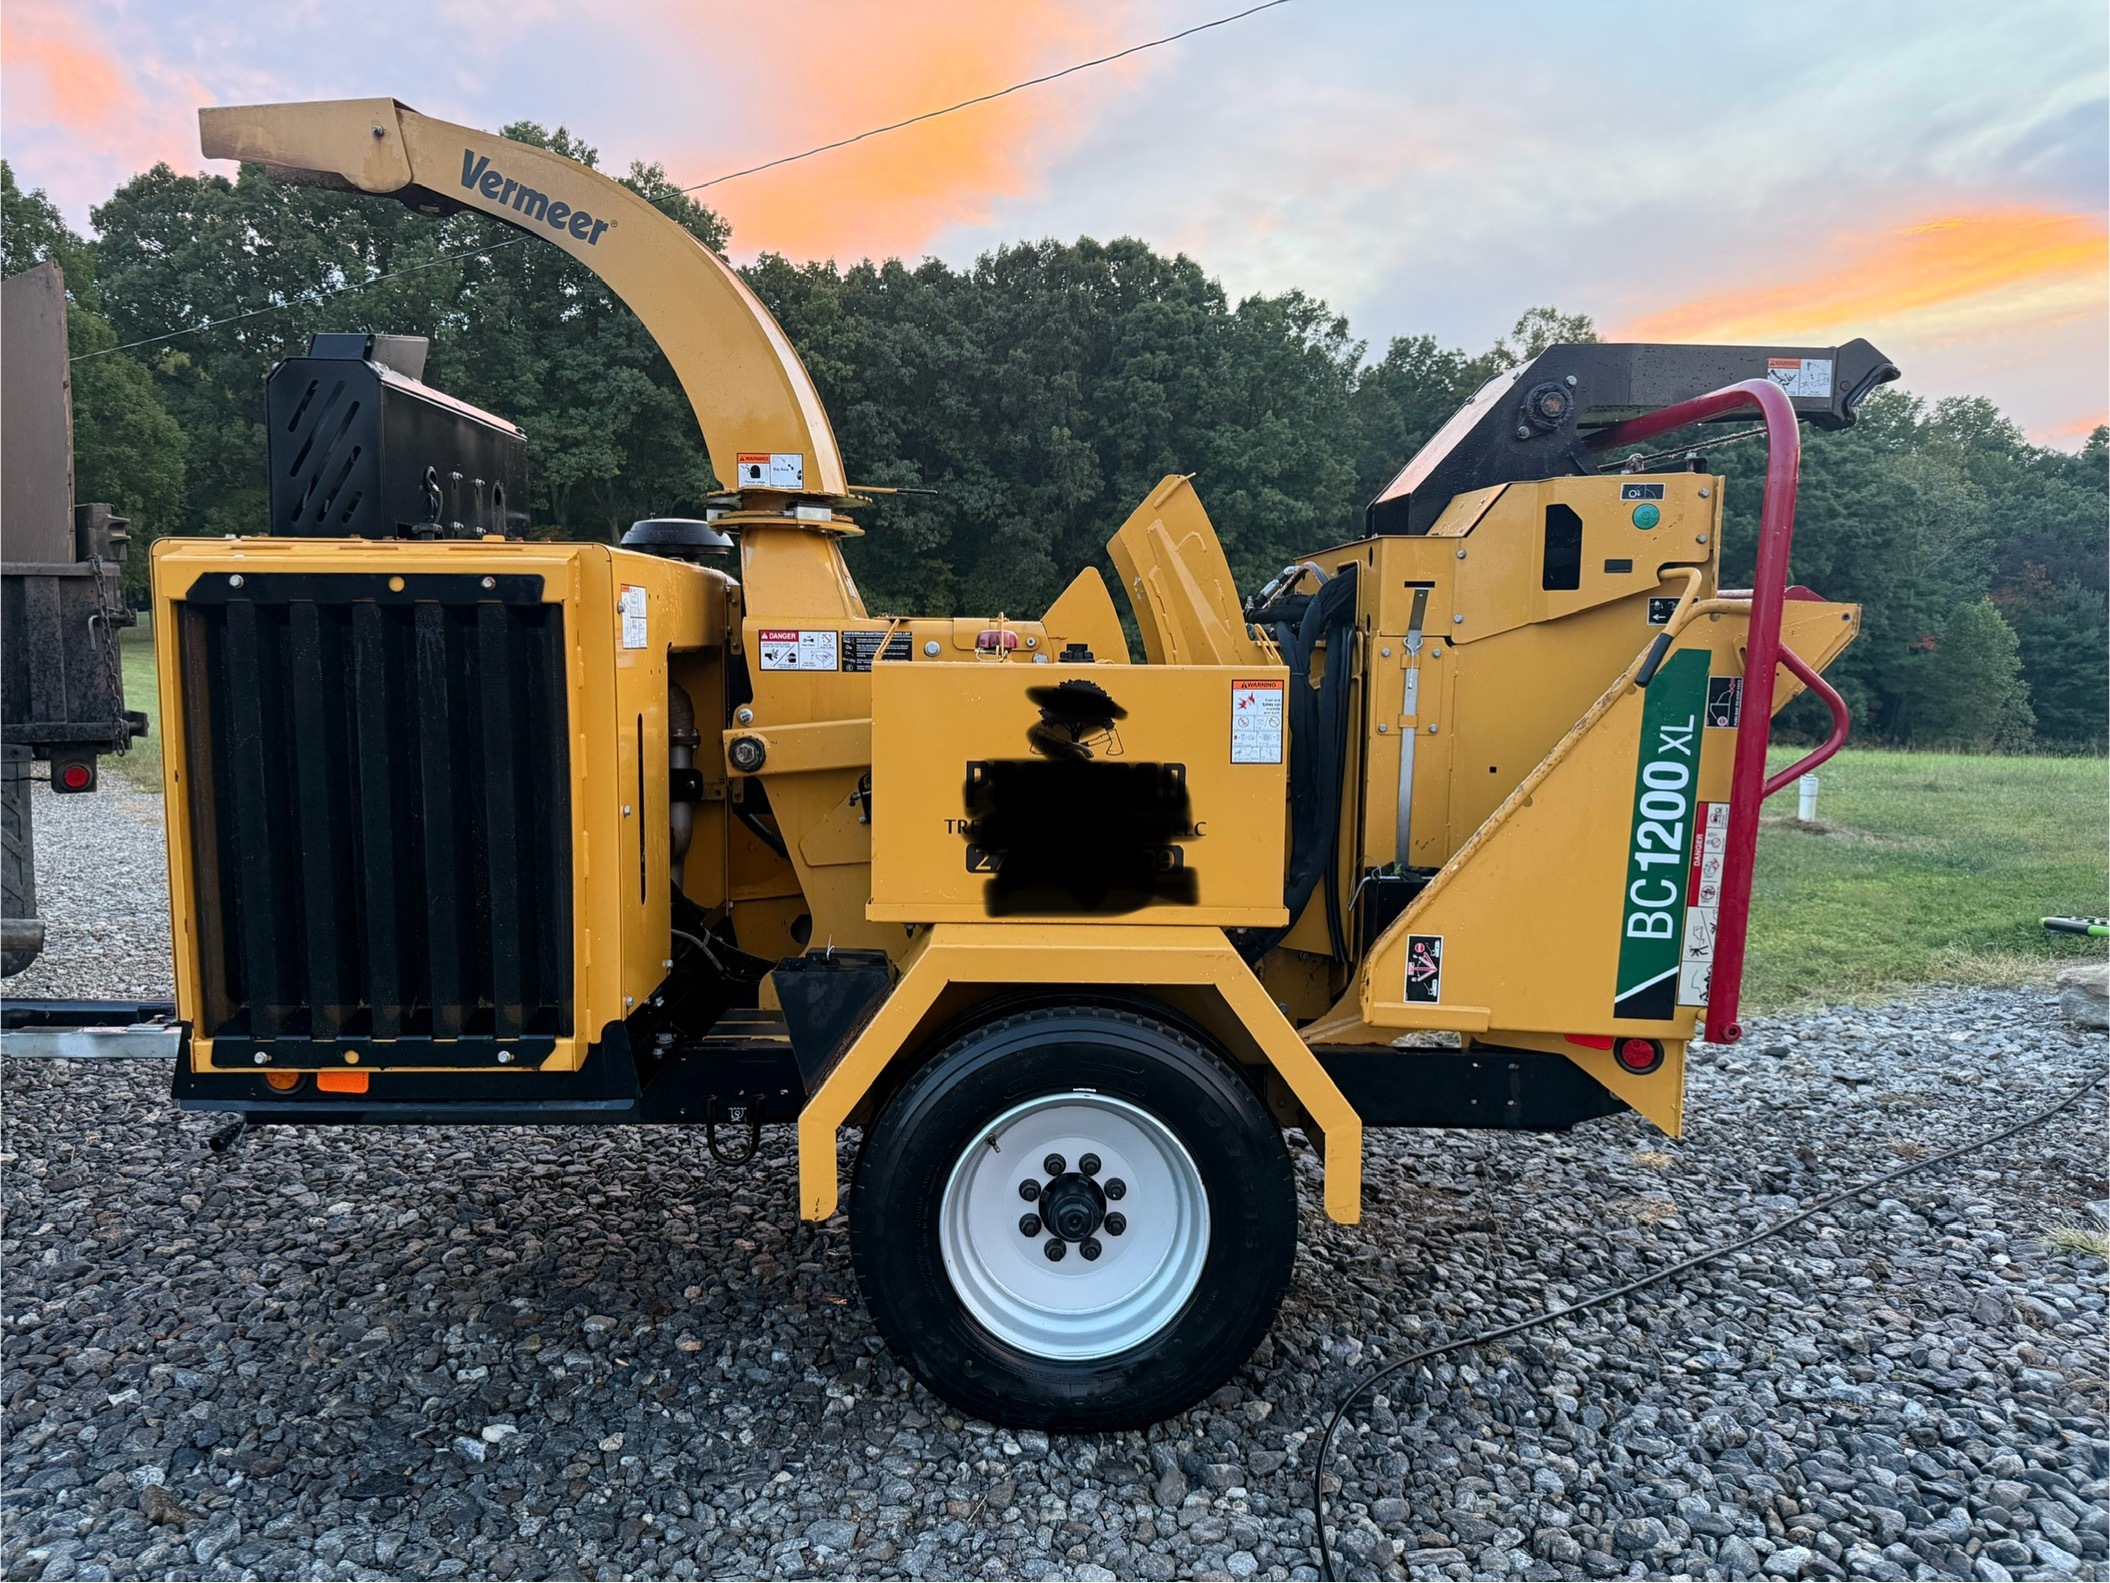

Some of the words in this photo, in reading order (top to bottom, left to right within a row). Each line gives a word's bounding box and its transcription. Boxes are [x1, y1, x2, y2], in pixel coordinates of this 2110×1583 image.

[461, 148, 609, 246] Vermeer
[768, 632, 797, 640] DANGER
[1658, 714, 1695, 756] XL
[1693, 833, 1704, 867] DANGER
